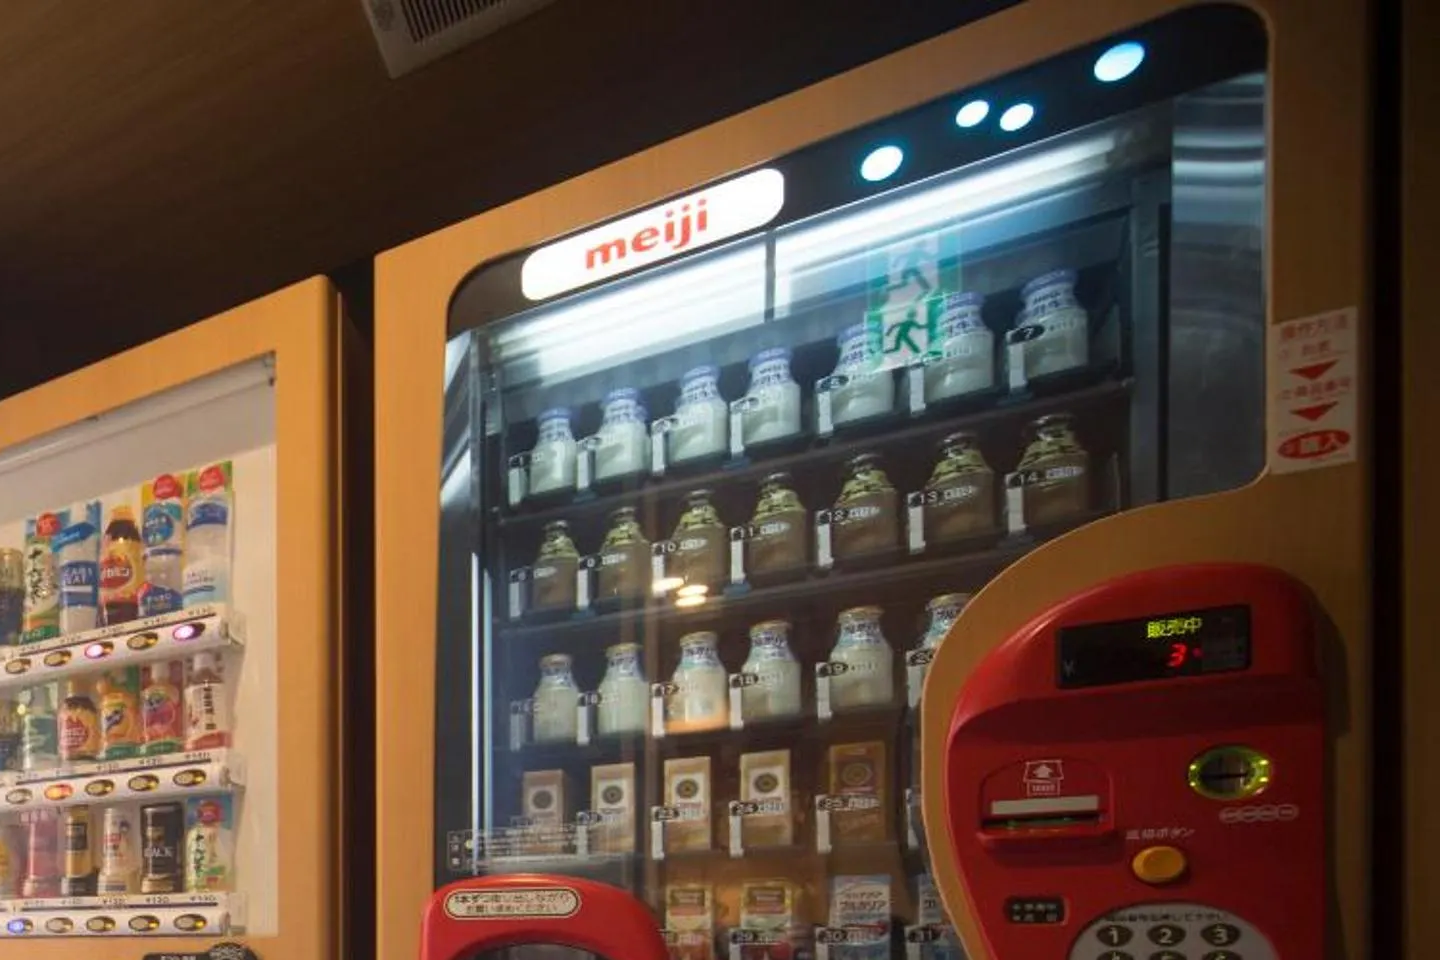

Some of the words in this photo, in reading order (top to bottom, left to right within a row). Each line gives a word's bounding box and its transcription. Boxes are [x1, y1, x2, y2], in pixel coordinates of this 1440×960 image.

[585, 198, 708, 270] meiji
[1147, 616, 1202, 638] 販売中
[1109, 927, 1120, 943] 1
[1159, 927, 1171, 943] 2
[1215, 926, 1228, 943] 3
